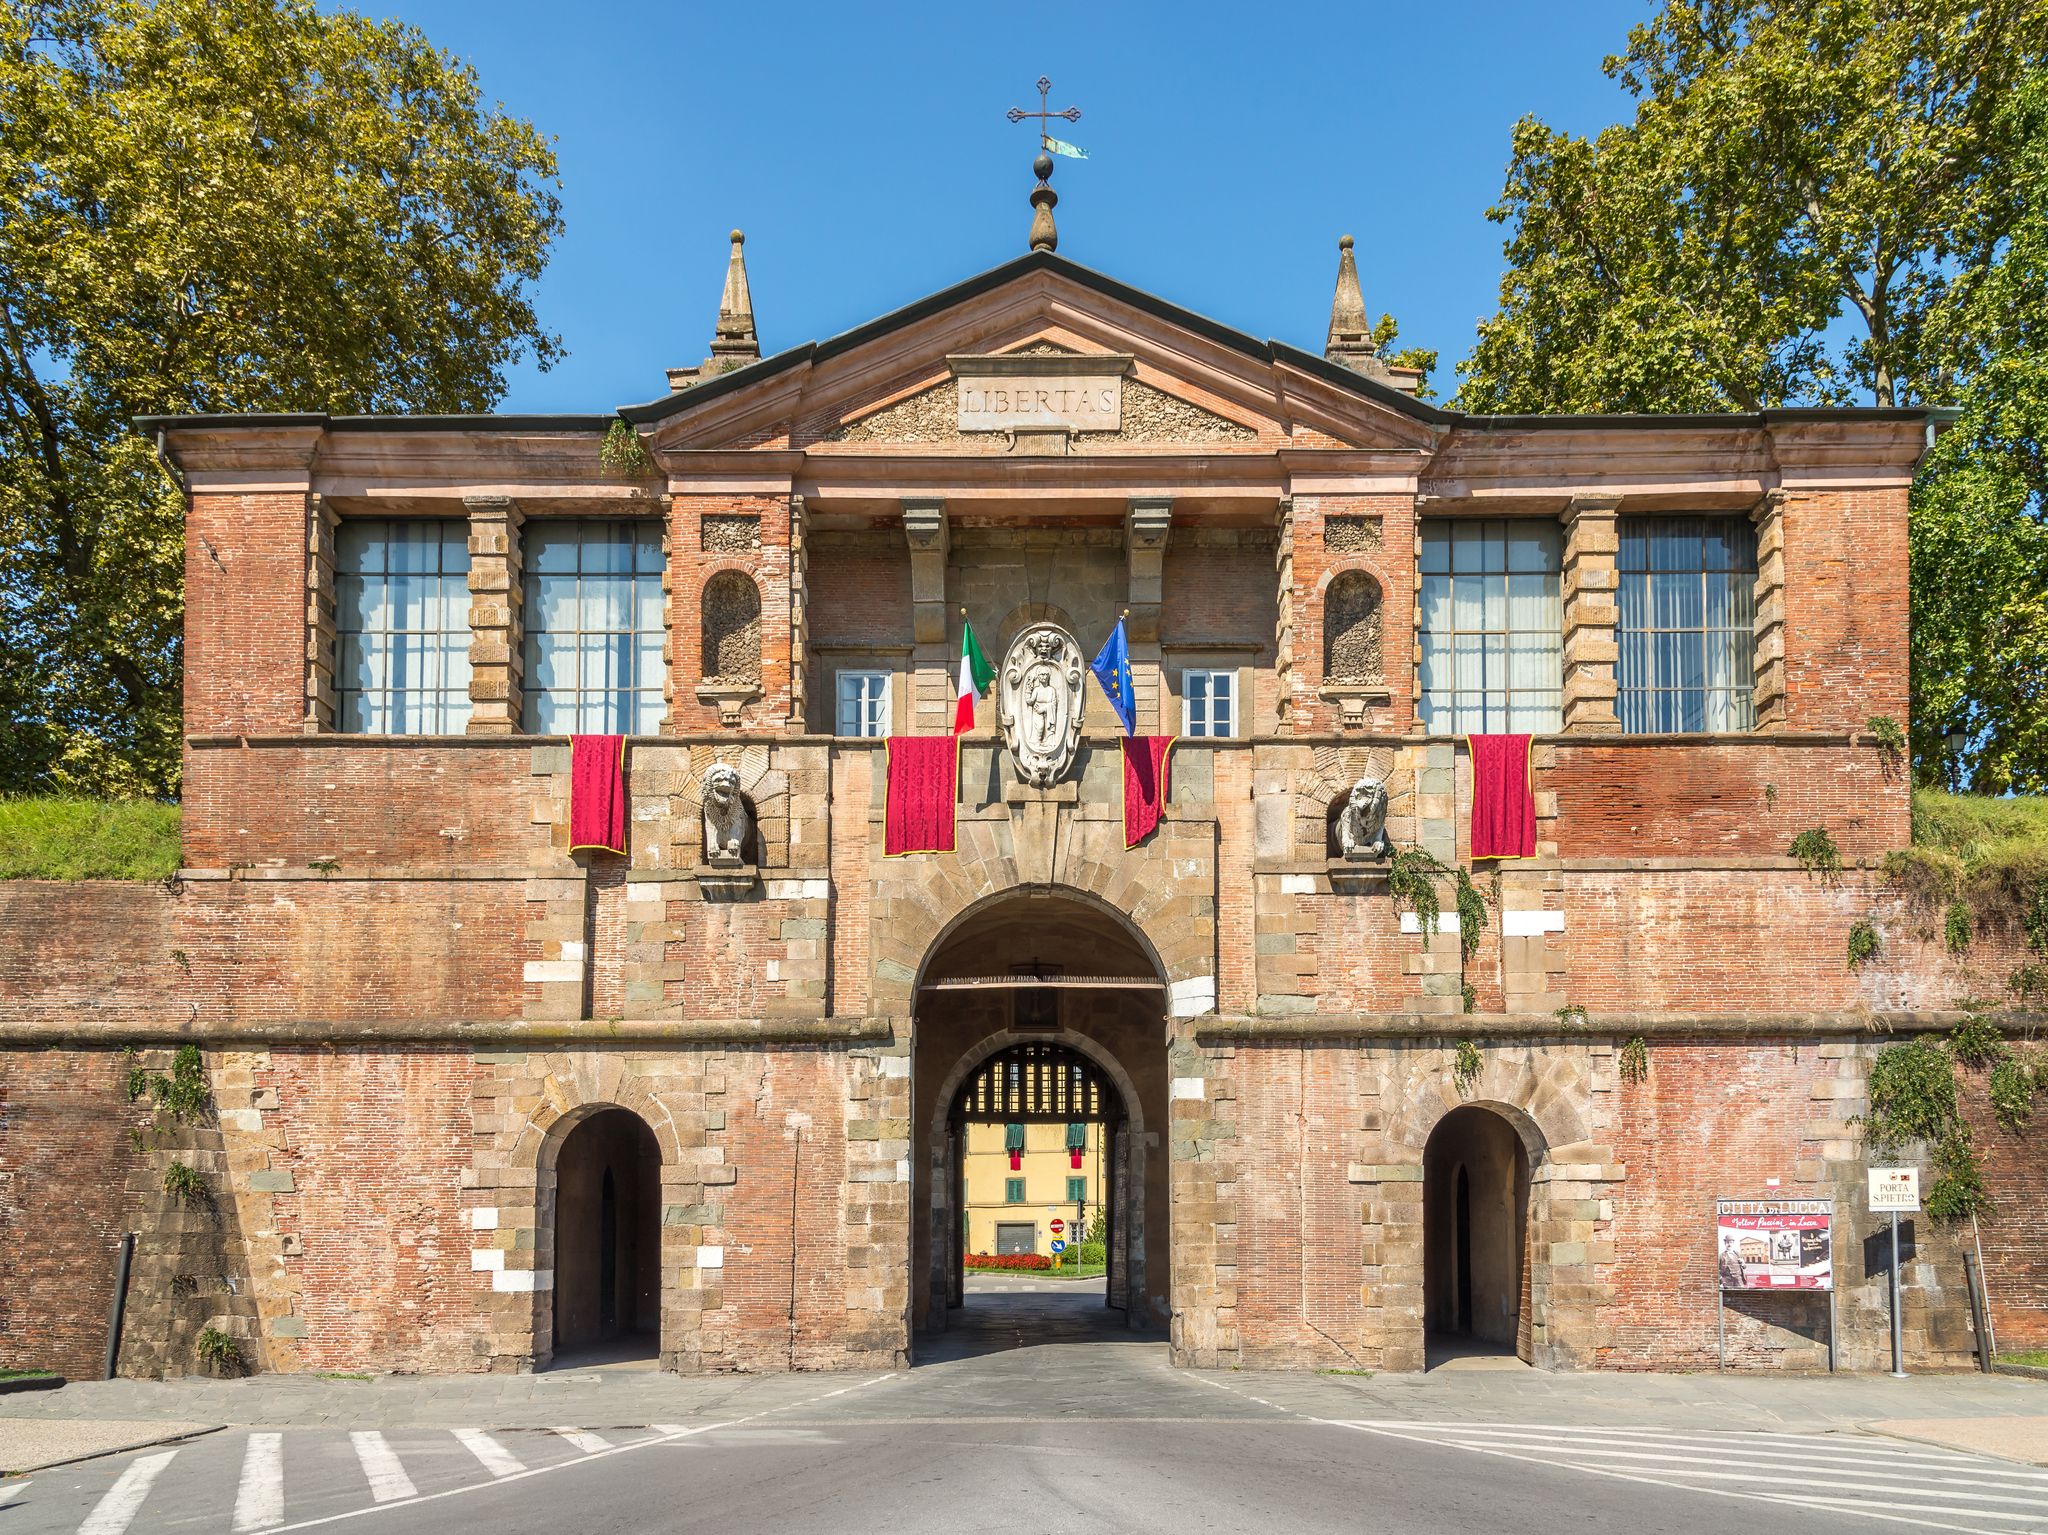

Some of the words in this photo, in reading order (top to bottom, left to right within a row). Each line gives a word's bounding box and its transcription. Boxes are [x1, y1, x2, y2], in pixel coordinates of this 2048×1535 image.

[963, 389, 1115, 414] LIBERTAS
[1879, 1183, 1909, 1192] PORTA
[1873, 1194, 1915, 1203] S.PIETRO
[1779, 1202, 1828, 1214] LUCCA
[1757, 1216, 1788, 1228] Puccini
[1798, 1216, 1818, 1227] Lucca
